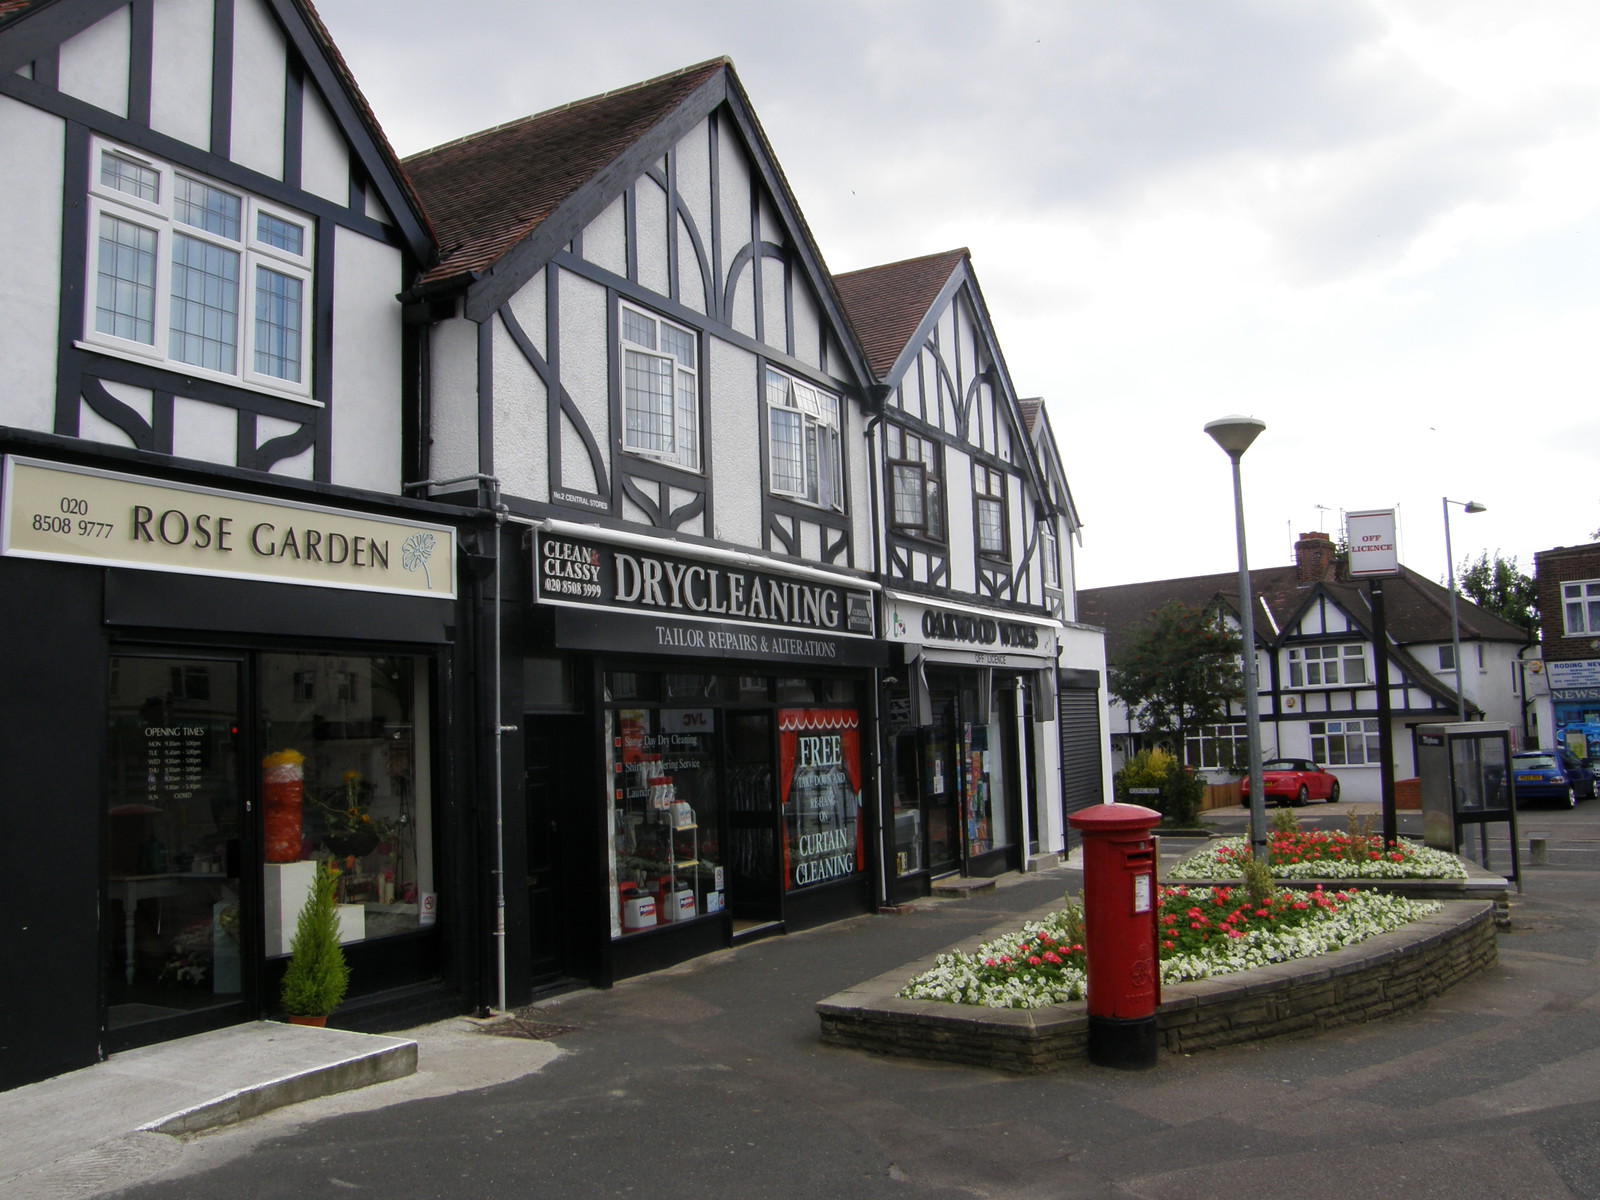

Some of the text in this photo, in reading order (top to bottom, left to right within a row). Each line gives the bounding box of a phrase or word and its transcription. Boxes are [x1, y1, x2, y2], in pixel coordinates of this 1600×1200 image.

[60, 497, 89, 516] 020
[553, 491, 608, 510] No.2 CENTRAL STORES
[32, 514, 114, 541] 8508 9777
[132, 504, 390, 570] ROSE GARDEN
[543, 540, 592, 564] CLEAN
[1351, 544, 1392, 552] LICENCE
[544, 558, 601, 582] CLASSY
[544, 578, 602, 598] 020 8508 3999
[613, 552, 839, 628] DRYCLEANING
[655, 626, 836, 658] TAILOR REPAIRS & ALTERATIONS
[921, 610, 1039, 650] OAKWOOD WINES
[975, 653, 1007, 665] OFF LICENCE
[144, 727, 205, 737] OPENING TIMES
[657, 734, 670, 748] Dry
[679, 757, 700, 770] Service
[799, 735, 843, 768] FREE
[800, 827, 848, 857] CURTAIN
[795, 853, 854, 886] CLEANING
